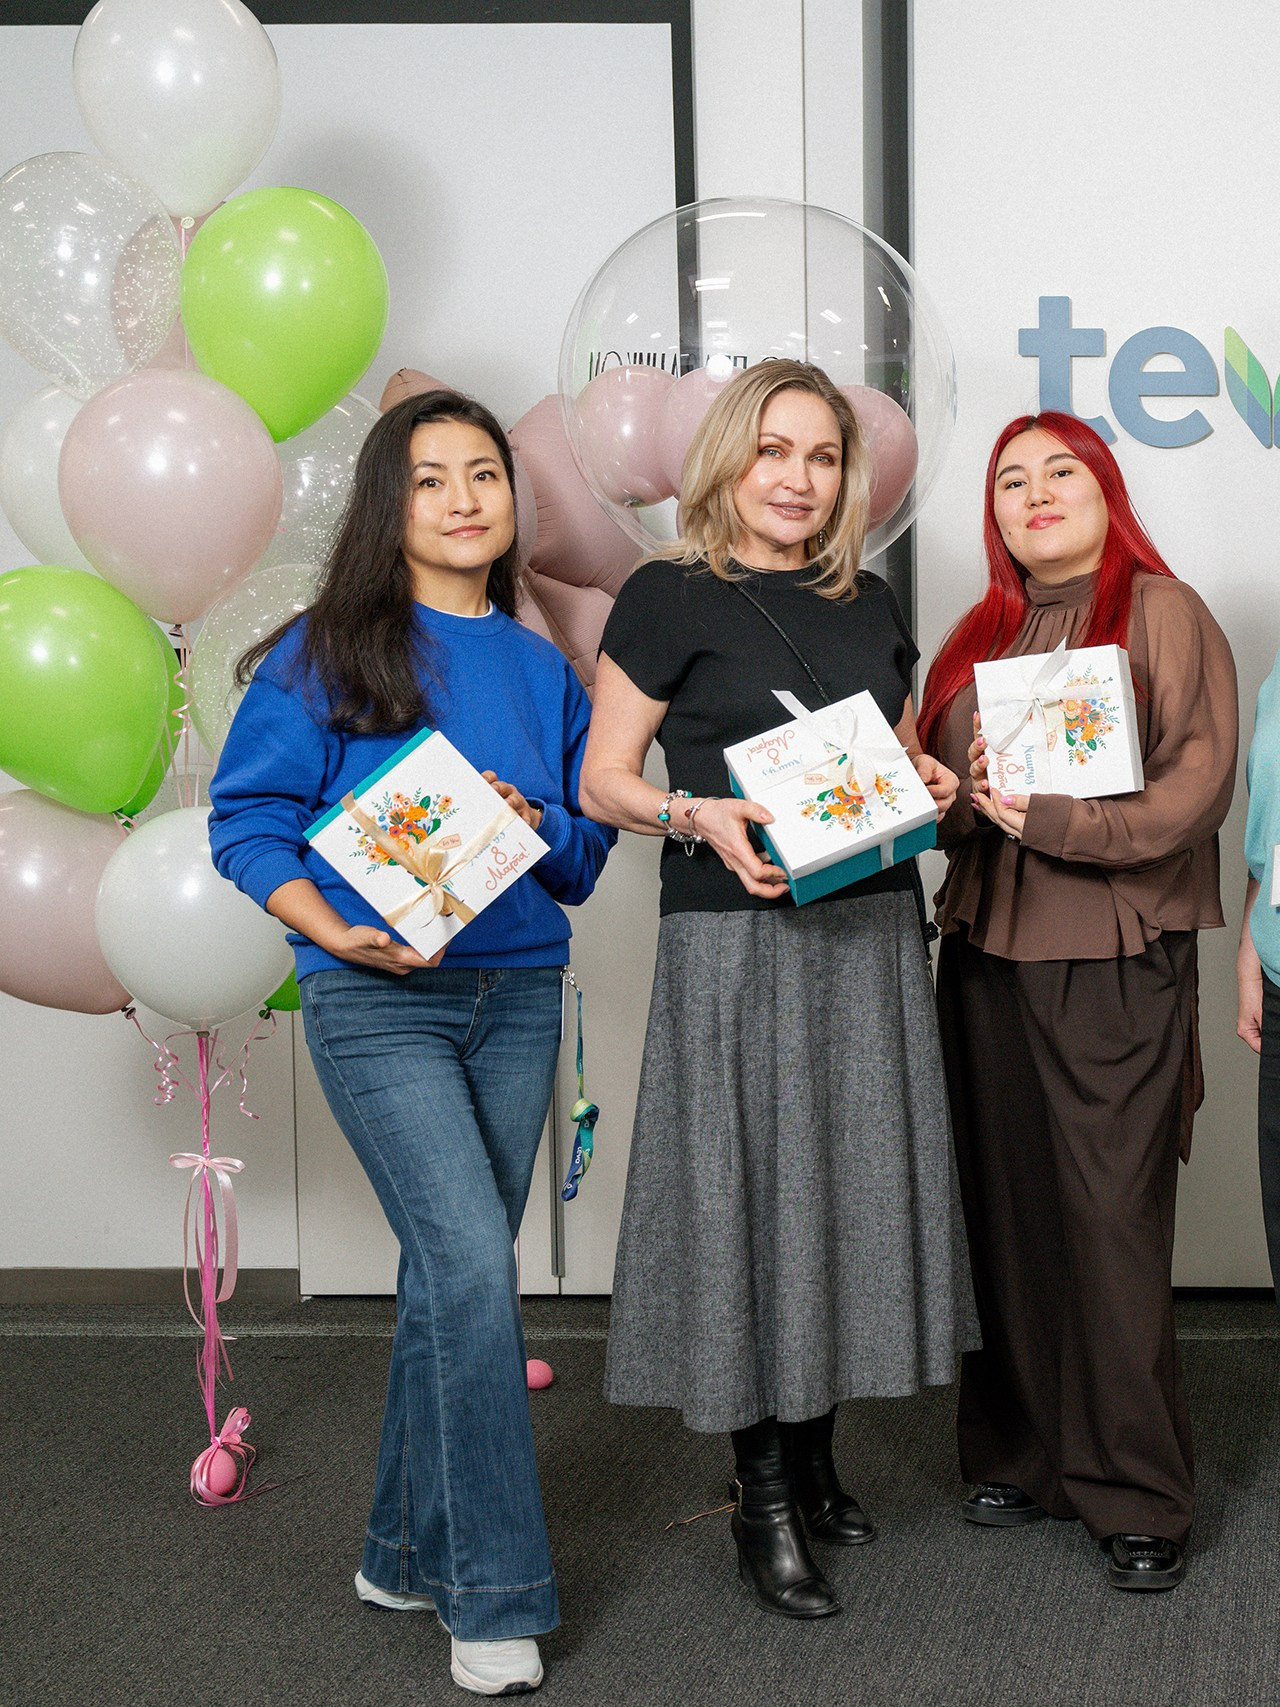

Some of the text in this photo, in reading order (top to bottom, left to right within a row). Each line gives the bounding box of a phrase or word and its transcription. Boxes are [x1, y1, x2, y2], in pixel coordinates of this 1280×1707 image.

[766, 748, 780, 766] 8
[1006, 763, 1025, 775] 8
[490, 846, 508, 865] 8
[574, 1145, 584, 1165] teva
